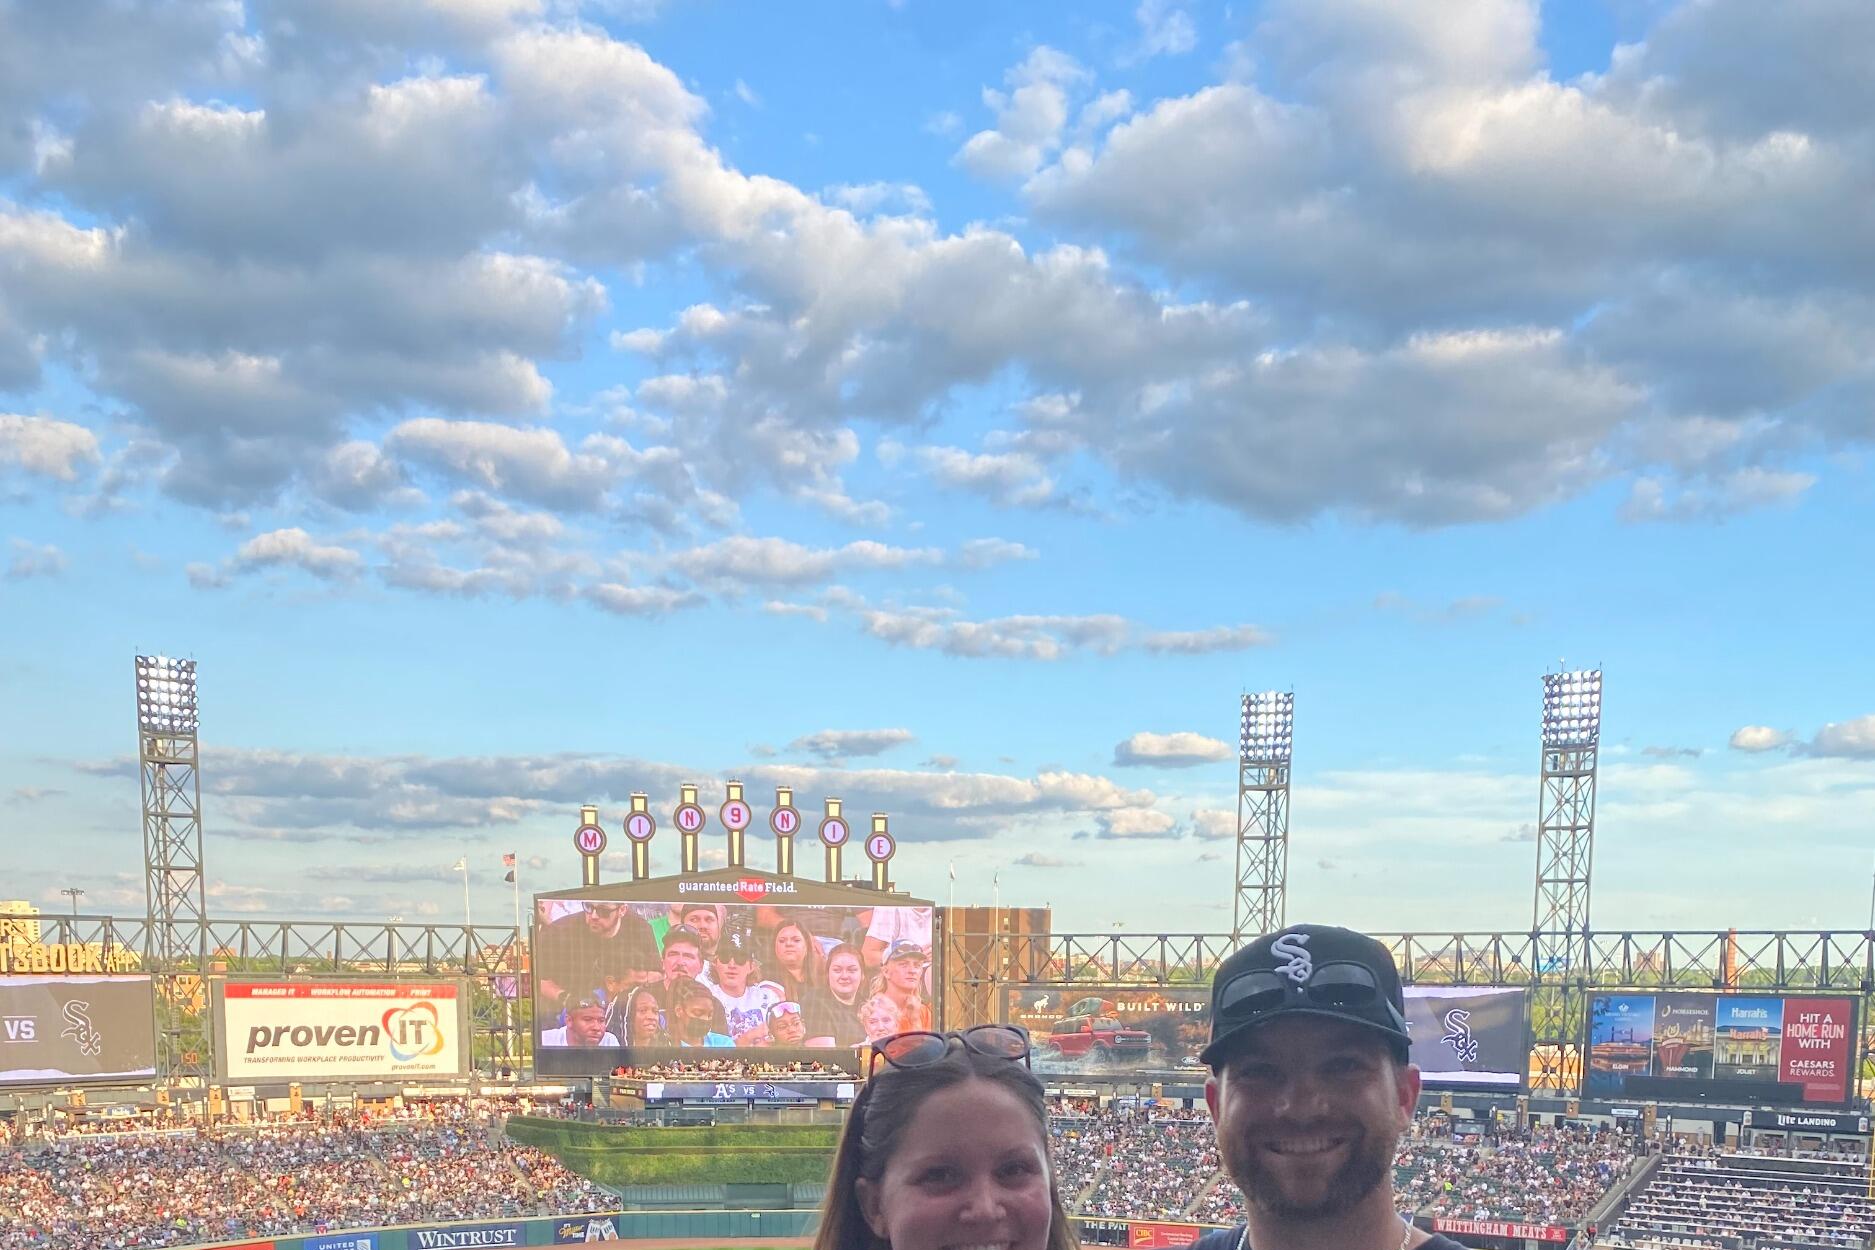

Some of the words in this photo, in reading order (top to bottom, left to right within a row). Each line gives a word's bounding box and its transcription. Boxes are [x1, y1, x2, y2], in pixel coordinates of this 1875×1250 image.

[678, 881, 739, 894] guaranteed
[740, 881, 764, 893] Rate
[271, 933, 312, 985] So
[1117, 1002, 1160, 1012] BUILT
[1800, 1013, 1821, 1024] HIT
[1823, 1013, 1833, 1024] A
[4, 1020, 35, 1040] VS
[1786, 1023, 1818, 1039] HOME
[1821, 1025, 1845, 1039] RUN
[246, 1024, 380, 1054] proven
[399, 1020, 427, 1045] IT
[1799, 1038, 1831, 1049] WITH
[243, 1056, 296, 1064] TRANSFORMING
[297, 1055, 337, 1063] WORKPLACE
[1789, 1059, 1835, 1069] CAESARS
[743, 1086, 755, 1095] VS
[1797, 1117, 1837, 1127] LANDING
[1084, 1220, 1106, 1229] THE
[1436, 1219, 1509, 1237] WHITTINGHAM
[1512, 1226, 1547, 1240] MEATS
[416, 1228, 519, 1247] WINTRUST
[318, 1240, 355, 1250] UNITED
